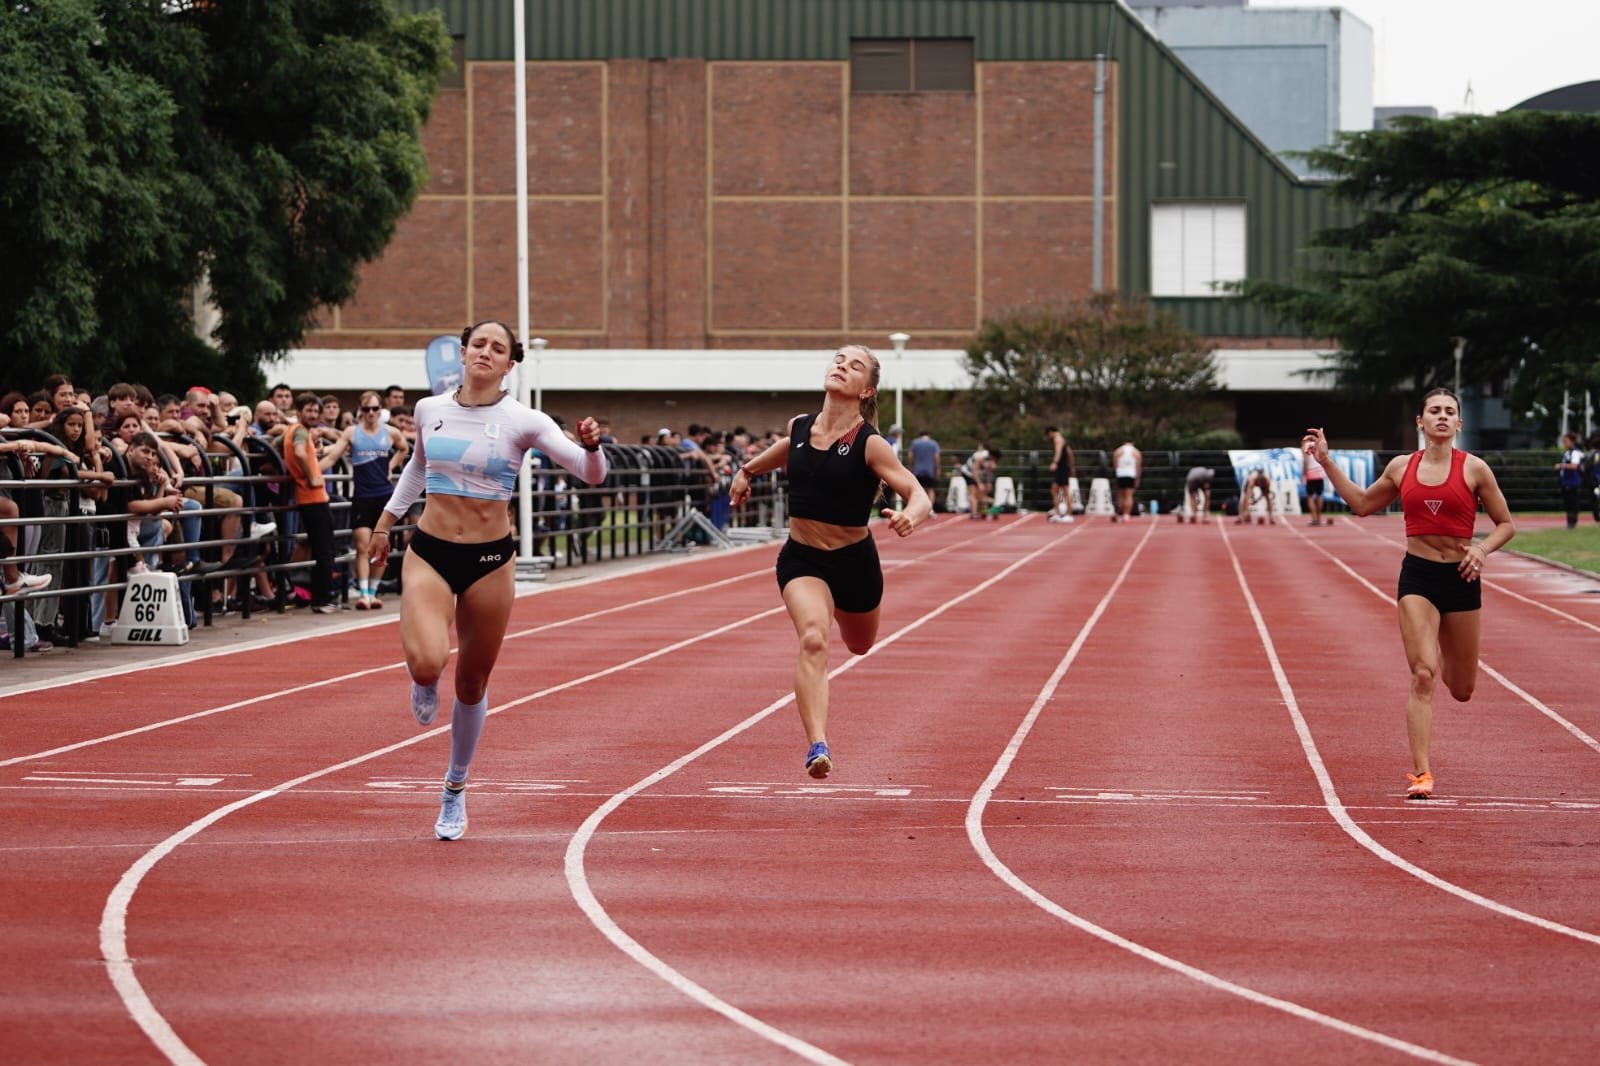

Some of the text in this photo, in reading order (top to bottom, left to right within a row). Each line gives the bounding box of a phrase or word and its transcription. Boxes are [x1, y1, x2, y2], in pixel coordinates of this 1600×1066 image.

[479, 554, 502, 562] ARG
[130, 584, 167, 602] 20m
[128, 629, 162, 641] GILL
